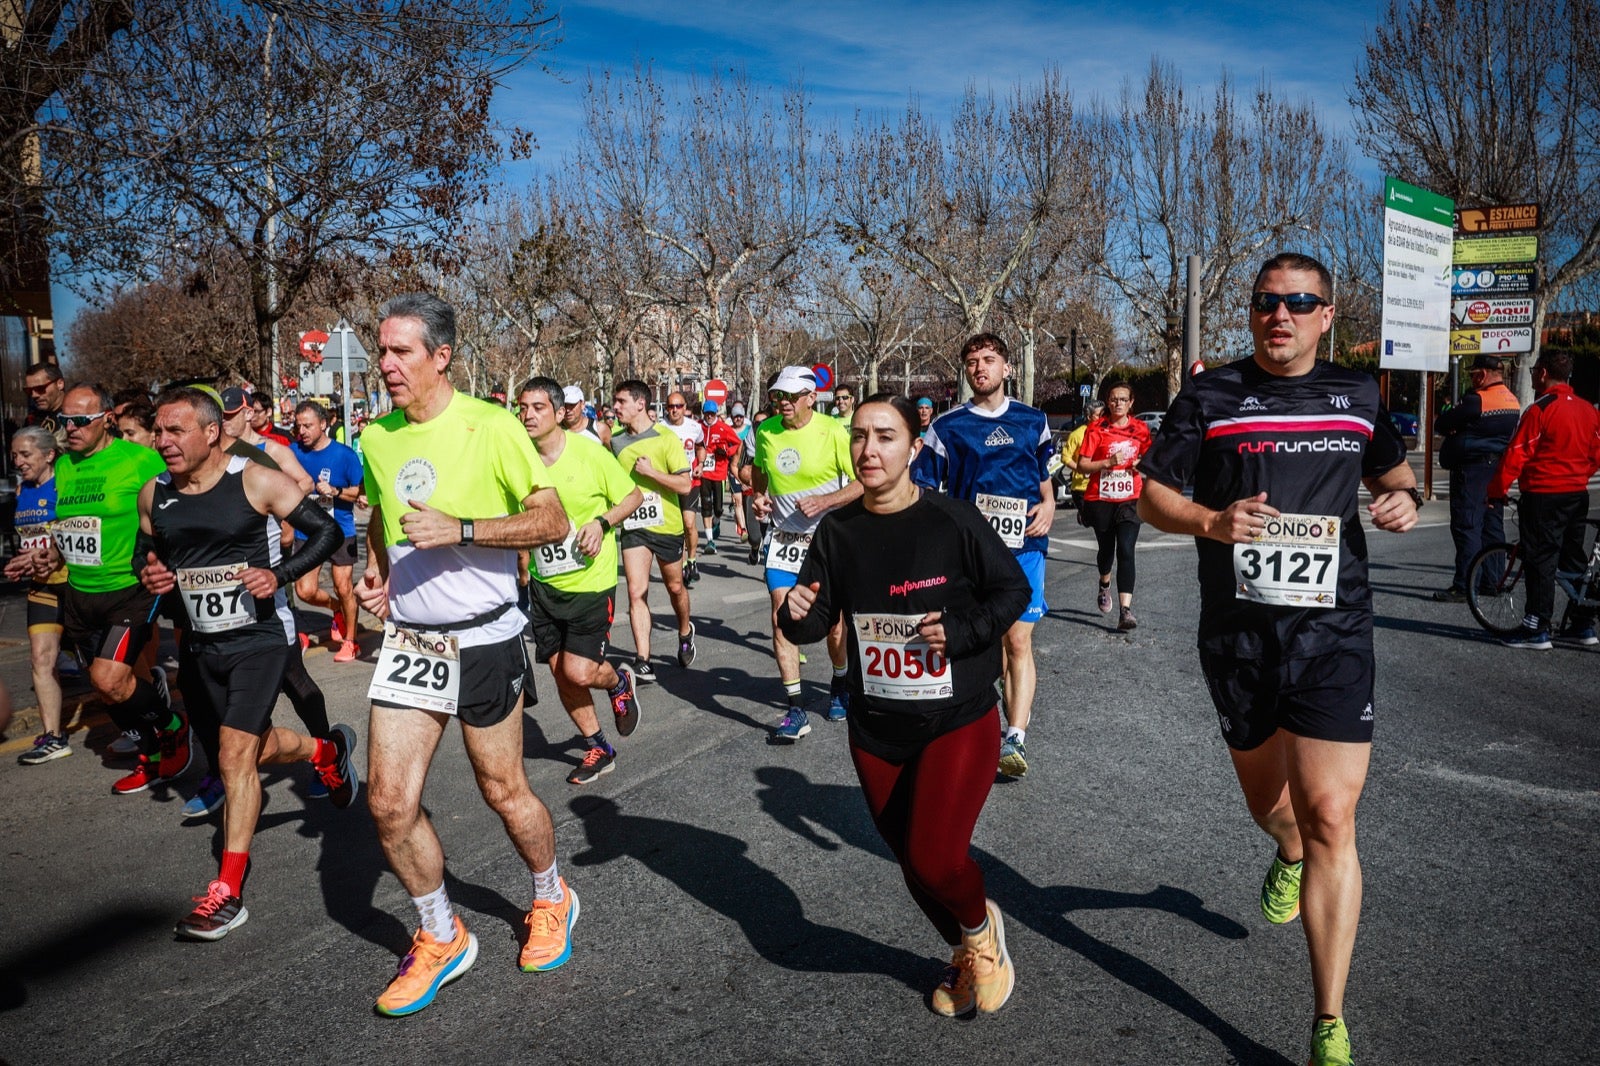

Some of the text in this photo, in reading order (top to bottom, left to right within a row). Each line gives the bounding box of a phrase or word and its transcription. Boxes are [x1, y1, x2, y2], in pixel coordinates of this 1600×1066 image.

[1490, 205, 1537, 220] ESTANCO
[1489, 222, 1508, 230] PRENSA
[1513, 220, 1536, 228] REVISTAS
[1490, 329, 1530, 338] DECOPAQ
[984, 436, 1014, 447] adidas
[1238, 437, 1361, 454] runrundata
[1102, 481, 1132, 492] 2196
[58, 493, 106, 506] MARCELINO
[987, 499, 1019, 511] FONDO
[629, 505, 657, 521] 488
[1284, 517, 1312, 525] PREMIO
[57, 533, 97, 554] 3148
[1240, 549, 1332, 584] 3127
[190, 571, 234, 585] FONDO
[190, 585, 241, 618] 787
[865, 646, 947, 680] 2050
[387, 654, 450, 692] 229
